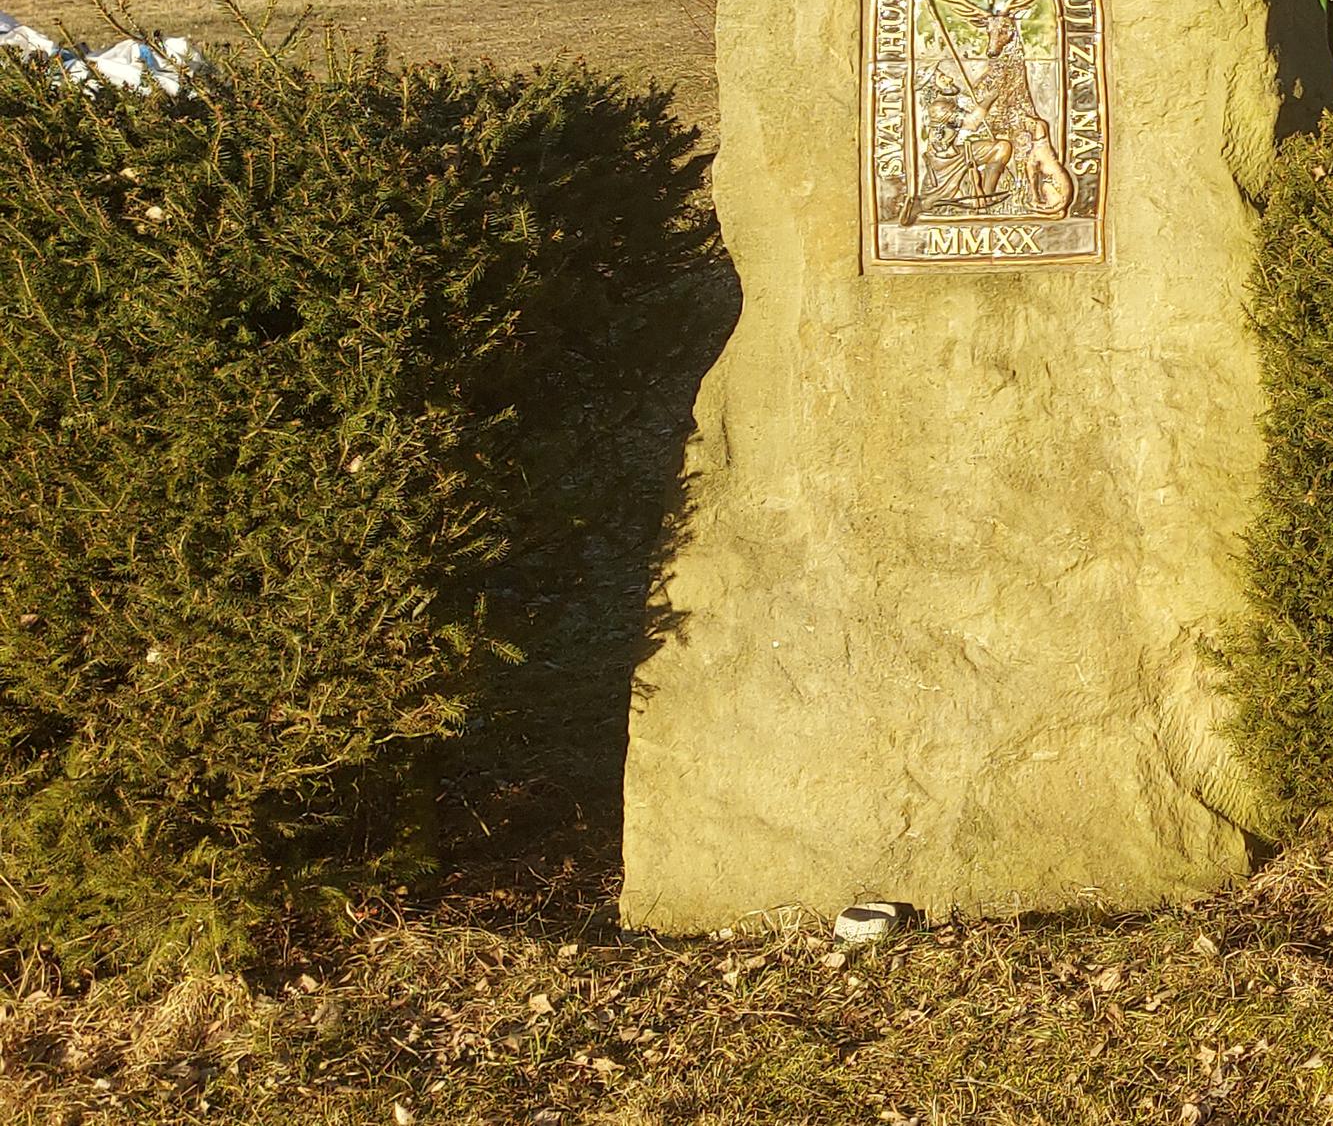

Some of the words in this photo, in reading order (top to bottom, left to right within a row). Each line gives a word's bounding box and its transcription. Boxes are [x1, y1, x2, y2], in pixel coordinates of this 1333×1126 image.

[1068, 43, 1096, 88] ZA
[873, 70, 905, 178] SVATÝ
[1070, 109, 1104, 176] NÁS
[926, 225, 1043, 255] MMXX
